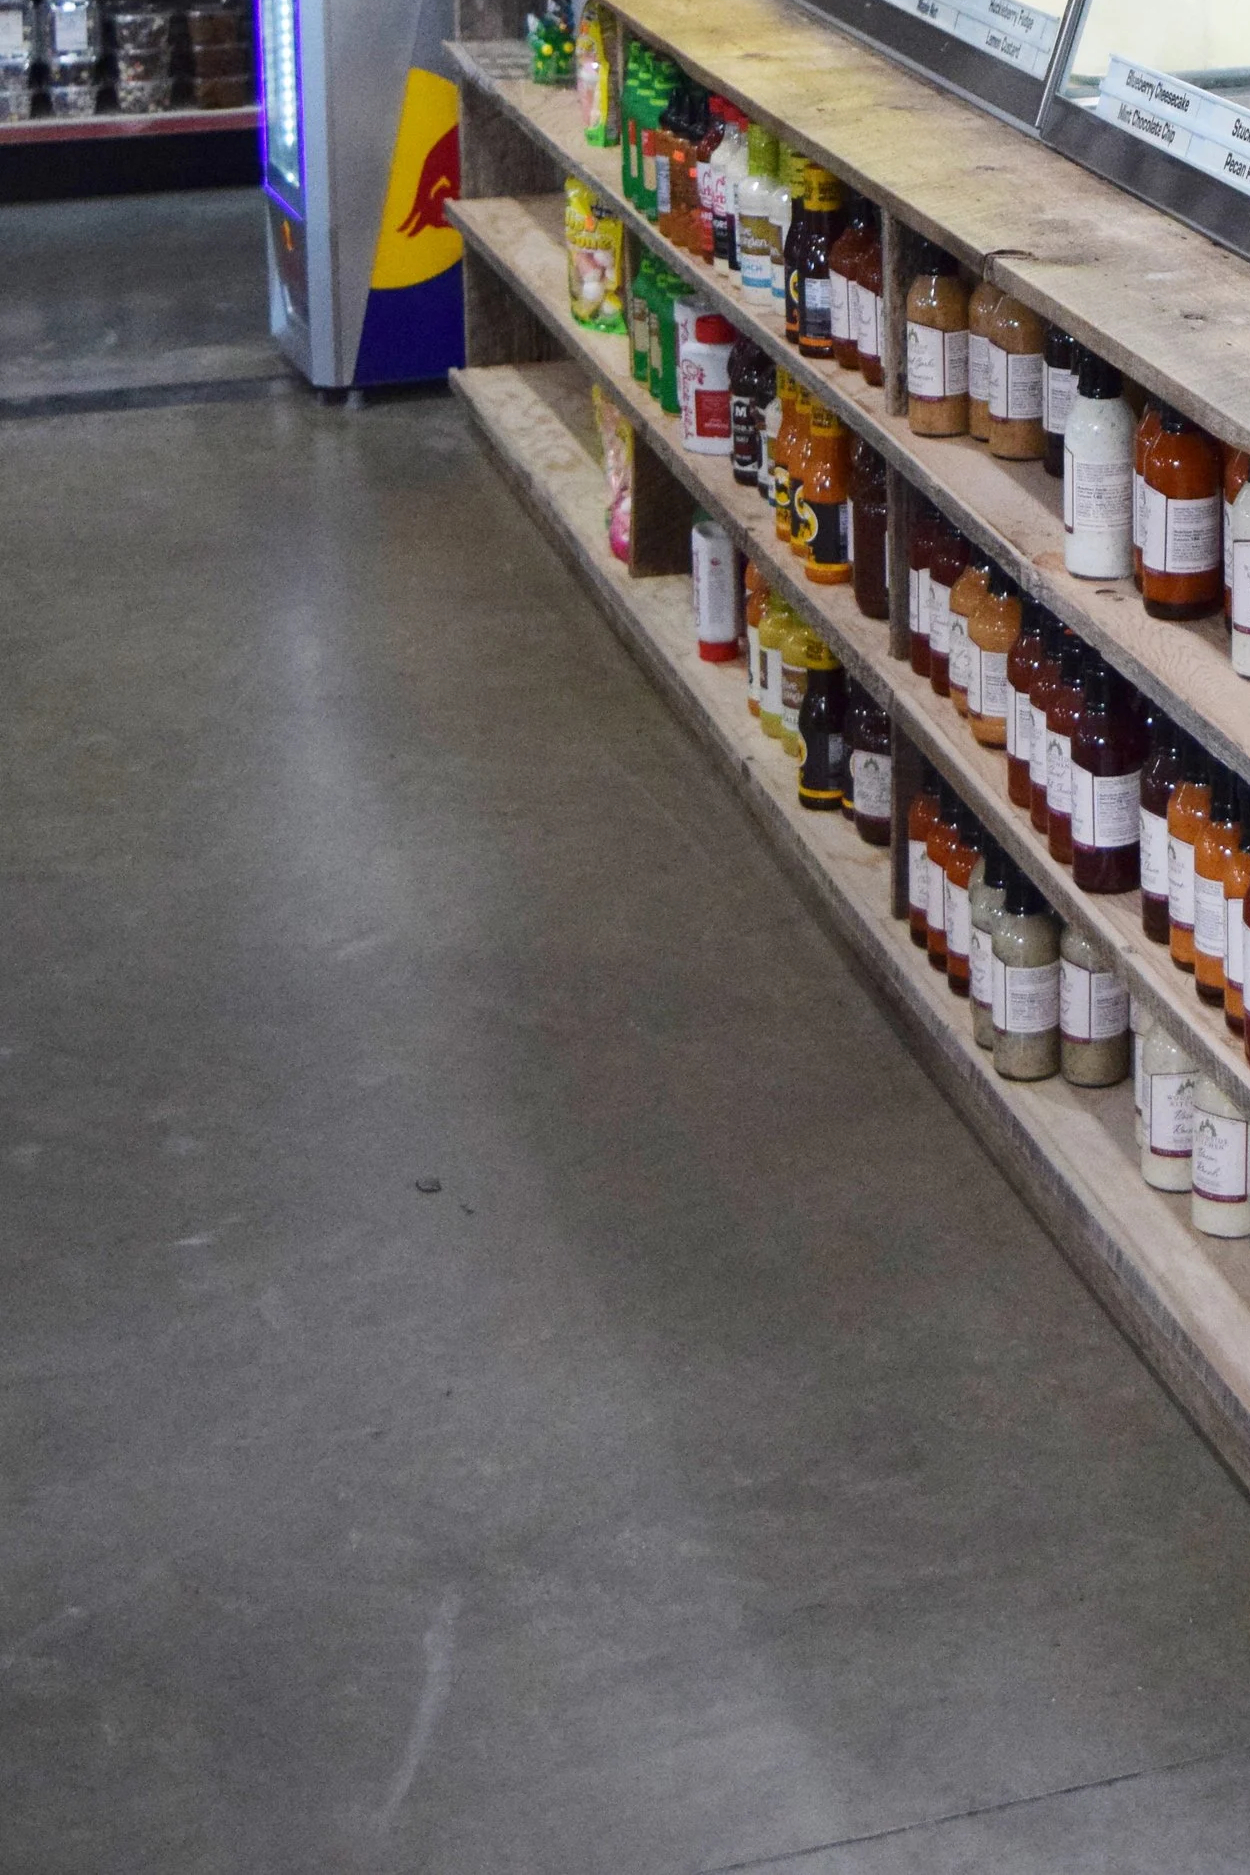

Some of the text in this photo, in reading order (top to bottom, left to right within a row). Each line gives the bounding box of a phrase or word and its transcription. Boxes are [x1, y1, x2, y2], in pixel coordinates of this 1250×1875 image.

[1125, 68, 1190, 113] Blueberry Cheesecake
[1117, 102, 1176, 147] Mint Chocolate Chip
[1223, 152, 1247, 177] Pecan
